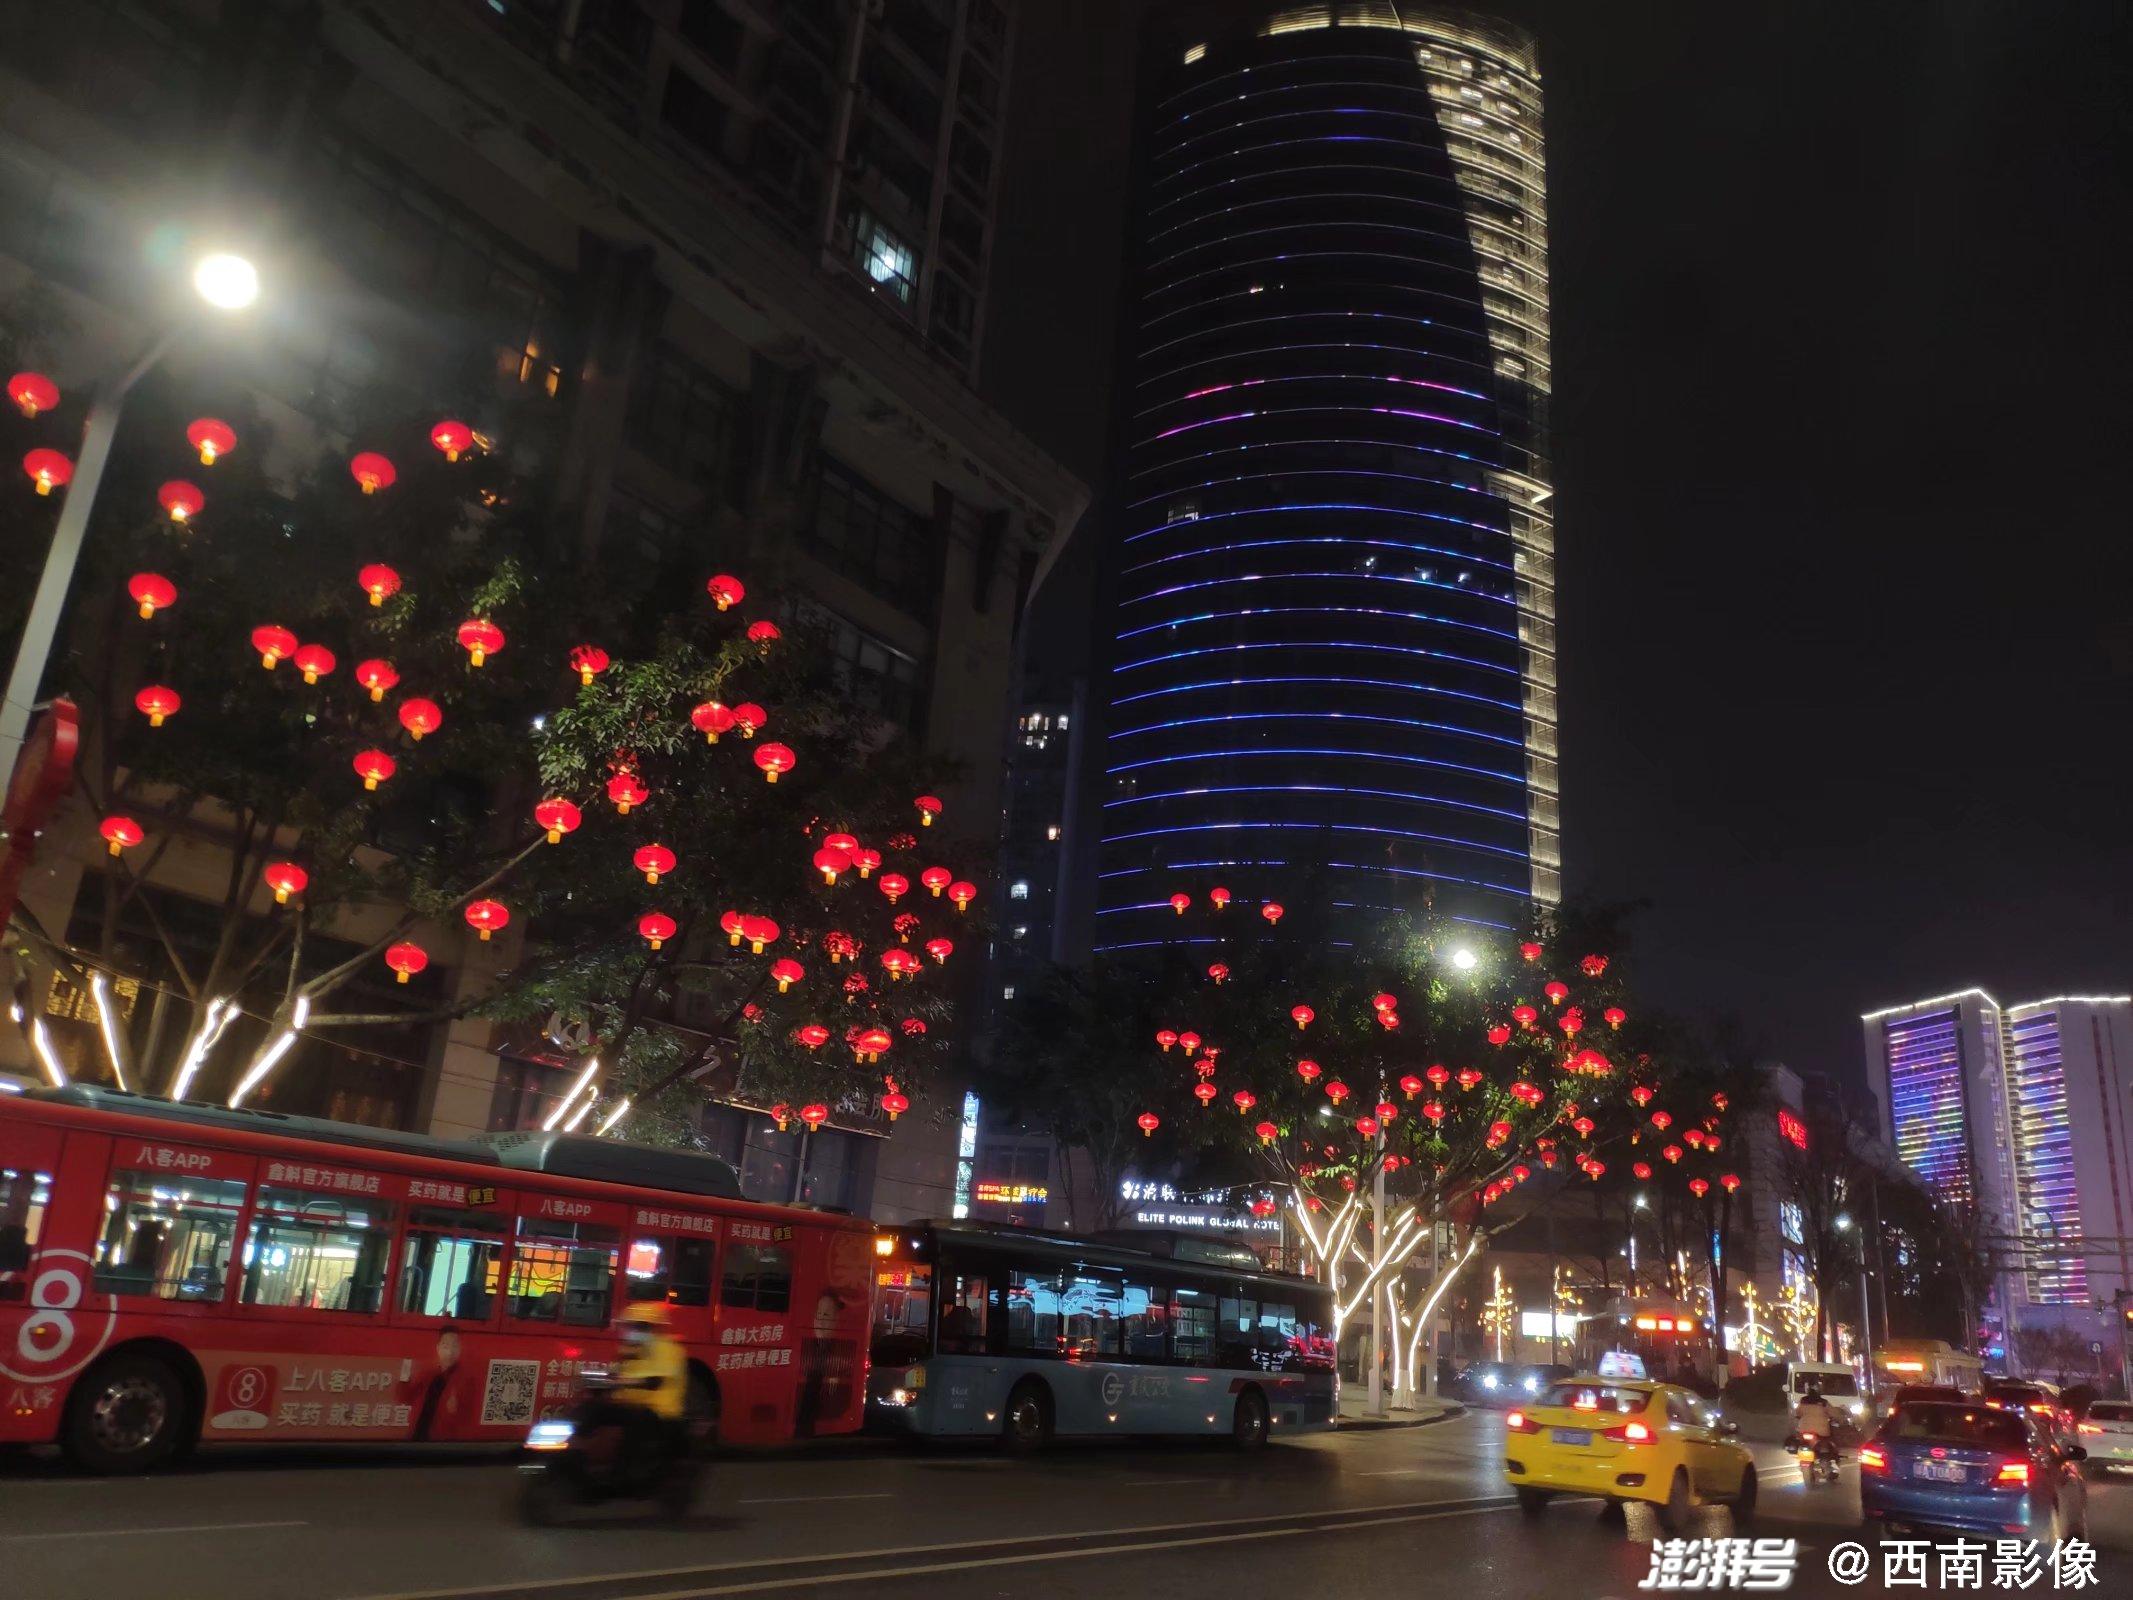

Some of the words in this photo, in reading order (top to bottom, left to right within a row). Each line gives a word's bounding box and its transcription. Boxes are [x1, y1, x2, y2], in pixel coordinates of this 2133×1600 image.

[136, 1146, 212, 1170] 八客APP
[540, 1199, 592, 1217] 八客APP
[1137, 1212, 1165, 1224] ELITE
[1169, 1214, 1205, 1227] POLINK
[281, 1365, 393, 1393] 上八客APP
